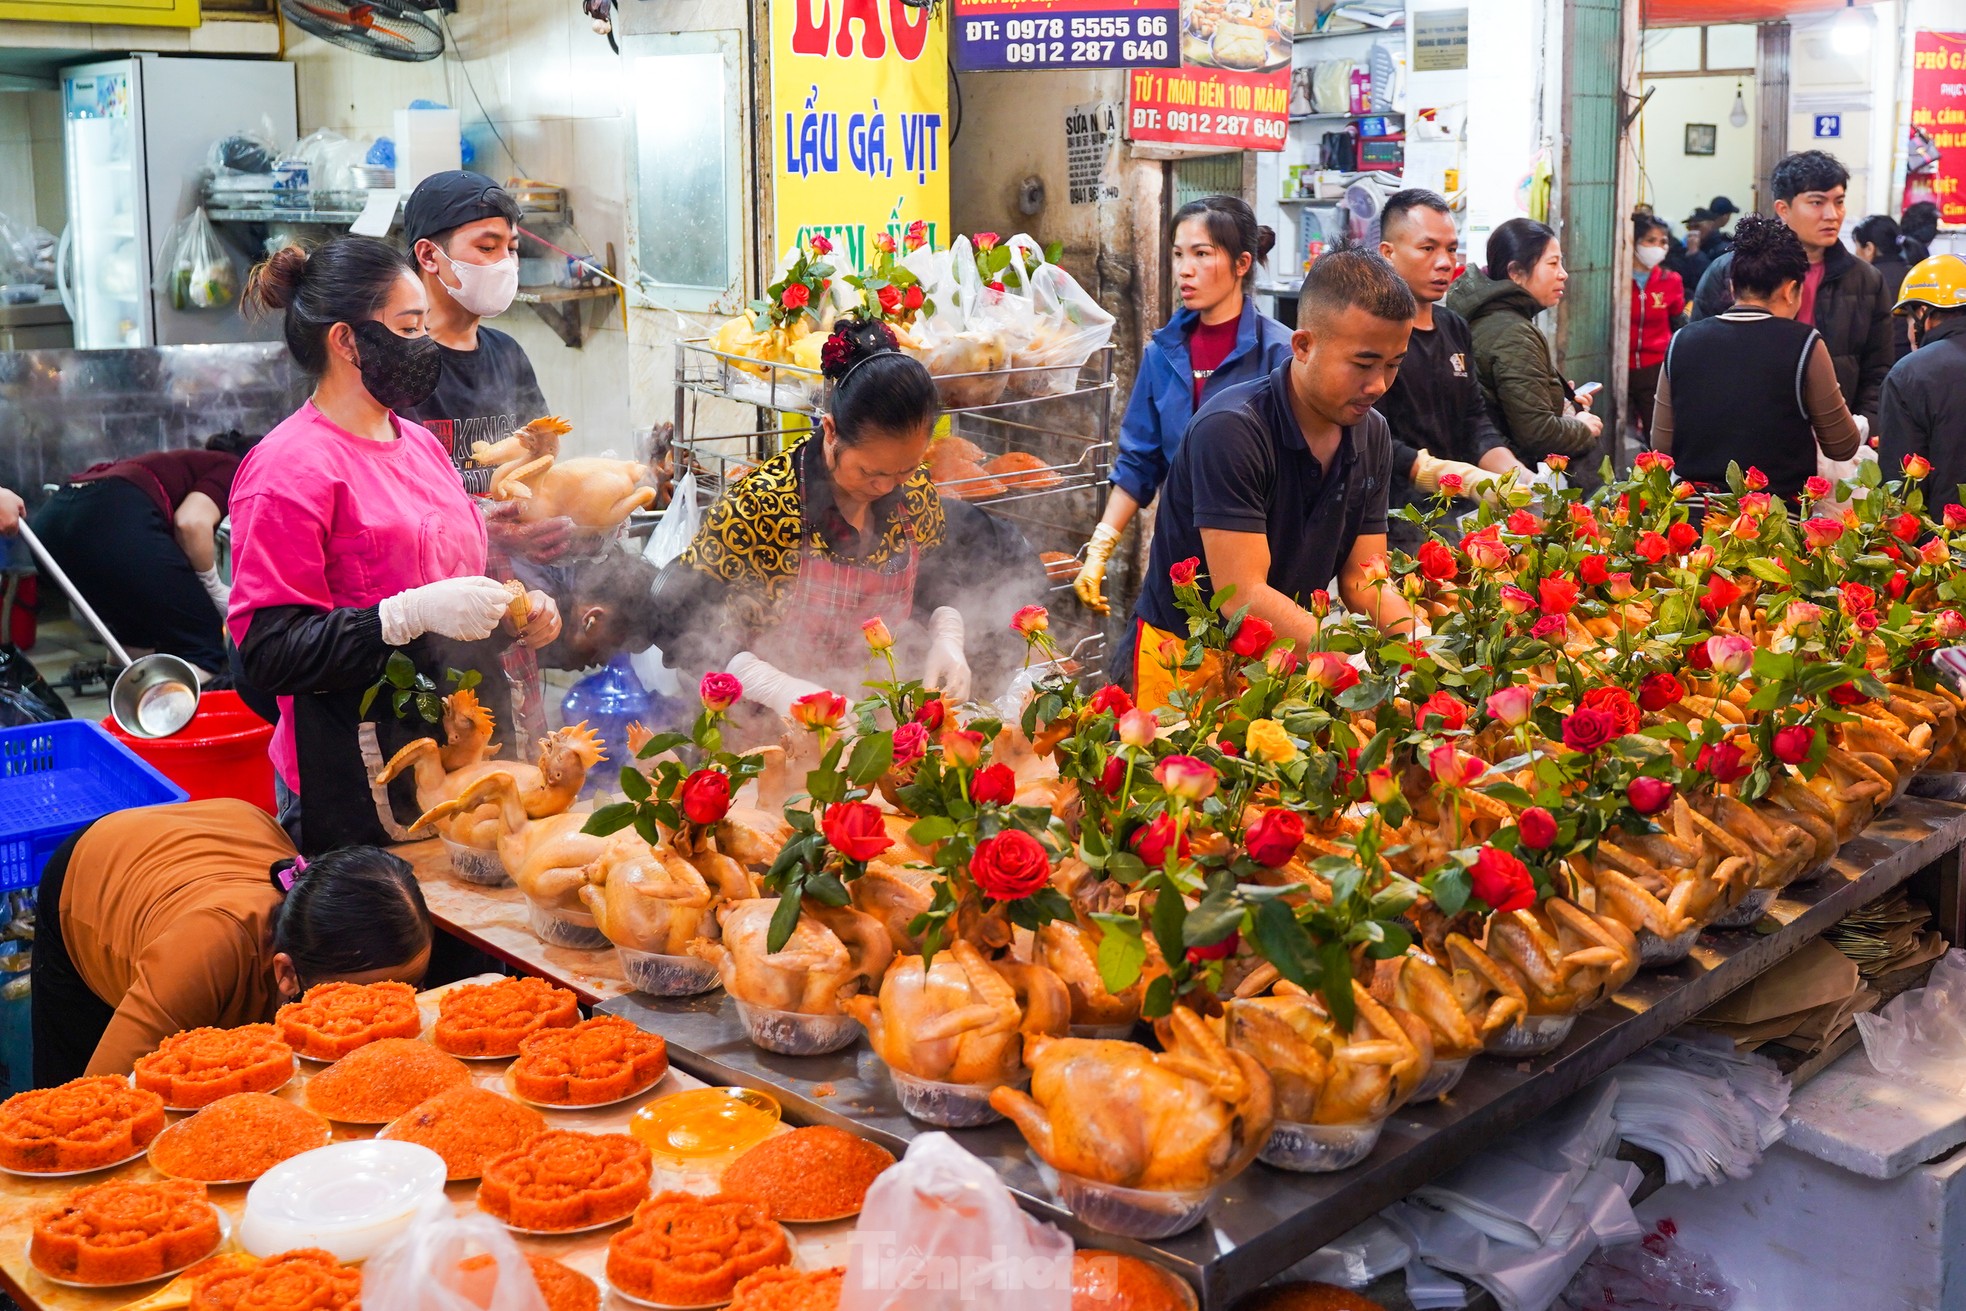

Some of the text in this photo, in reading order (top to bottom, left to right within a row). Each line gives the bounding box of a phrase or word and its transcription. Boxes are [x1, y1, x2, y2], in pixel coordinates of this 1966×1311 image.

[966, 16, 1168, 41] ĐT: 0978 5555 66
[1006, 40, 1168, 63] 0912 287 640
[1915, 46, 1948, 70] PHỞ
[1135, 71, 1287, 114] TỪ 1 MÓN ĐẾN 100 MÂM
[786, 85, 941, 185] LẨU GÀ, VỊT
[1066, 105, 1115, 135] SỬA NÀ
[1133, 108, 1286, 139] ĐT: 0912 287 640
